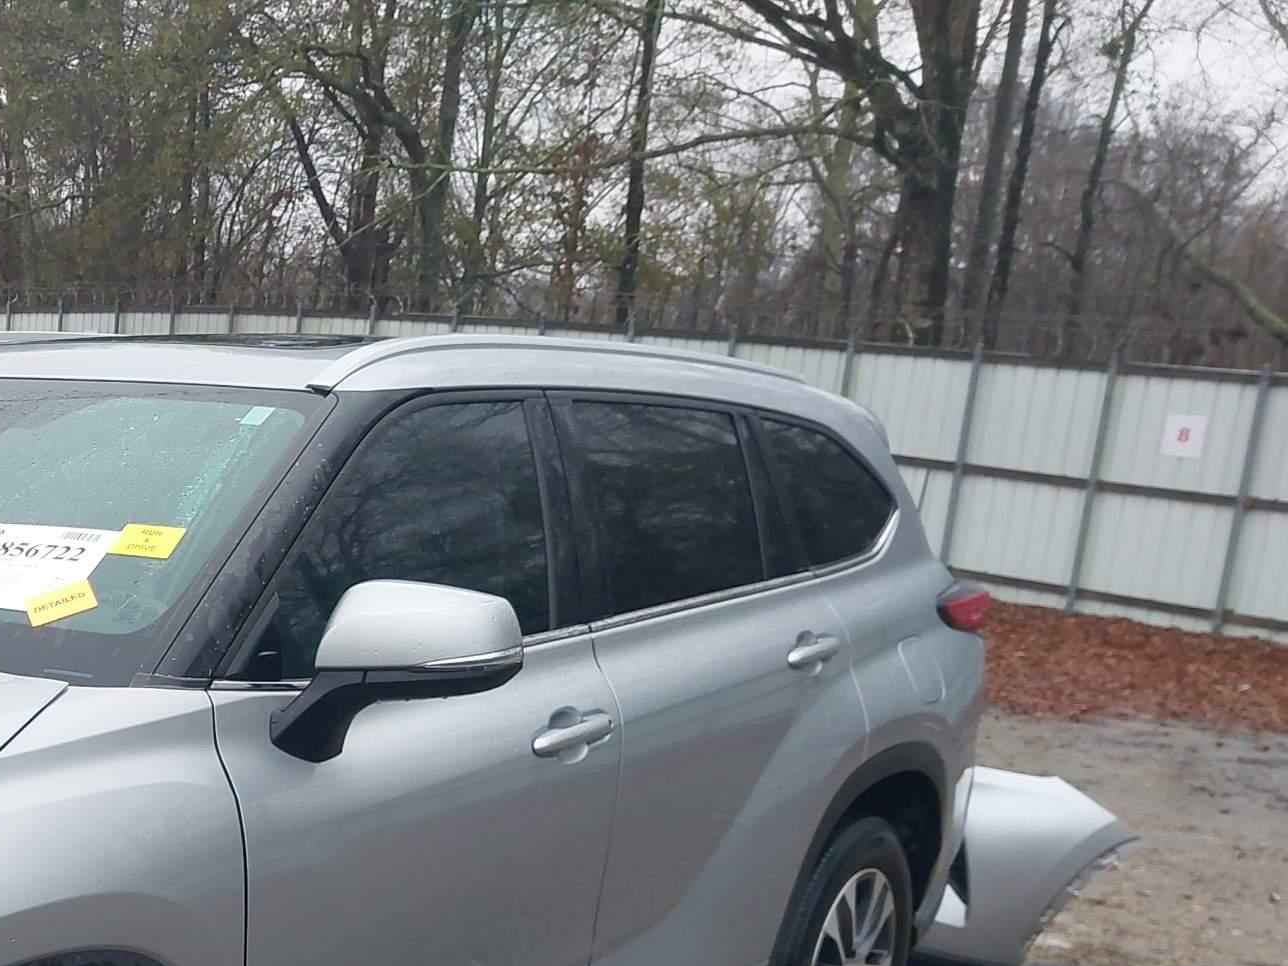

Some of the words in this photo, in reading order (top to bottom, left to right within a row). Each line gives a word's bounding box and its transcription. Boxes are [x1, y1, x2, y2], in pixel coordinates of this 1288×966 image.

[1177, 426, 1191, 443] 8
[141, 529, 164, 537] RUN
[126, 543, 158, 552] DRIVE
[33, 592, 86, 614] DETAILED
